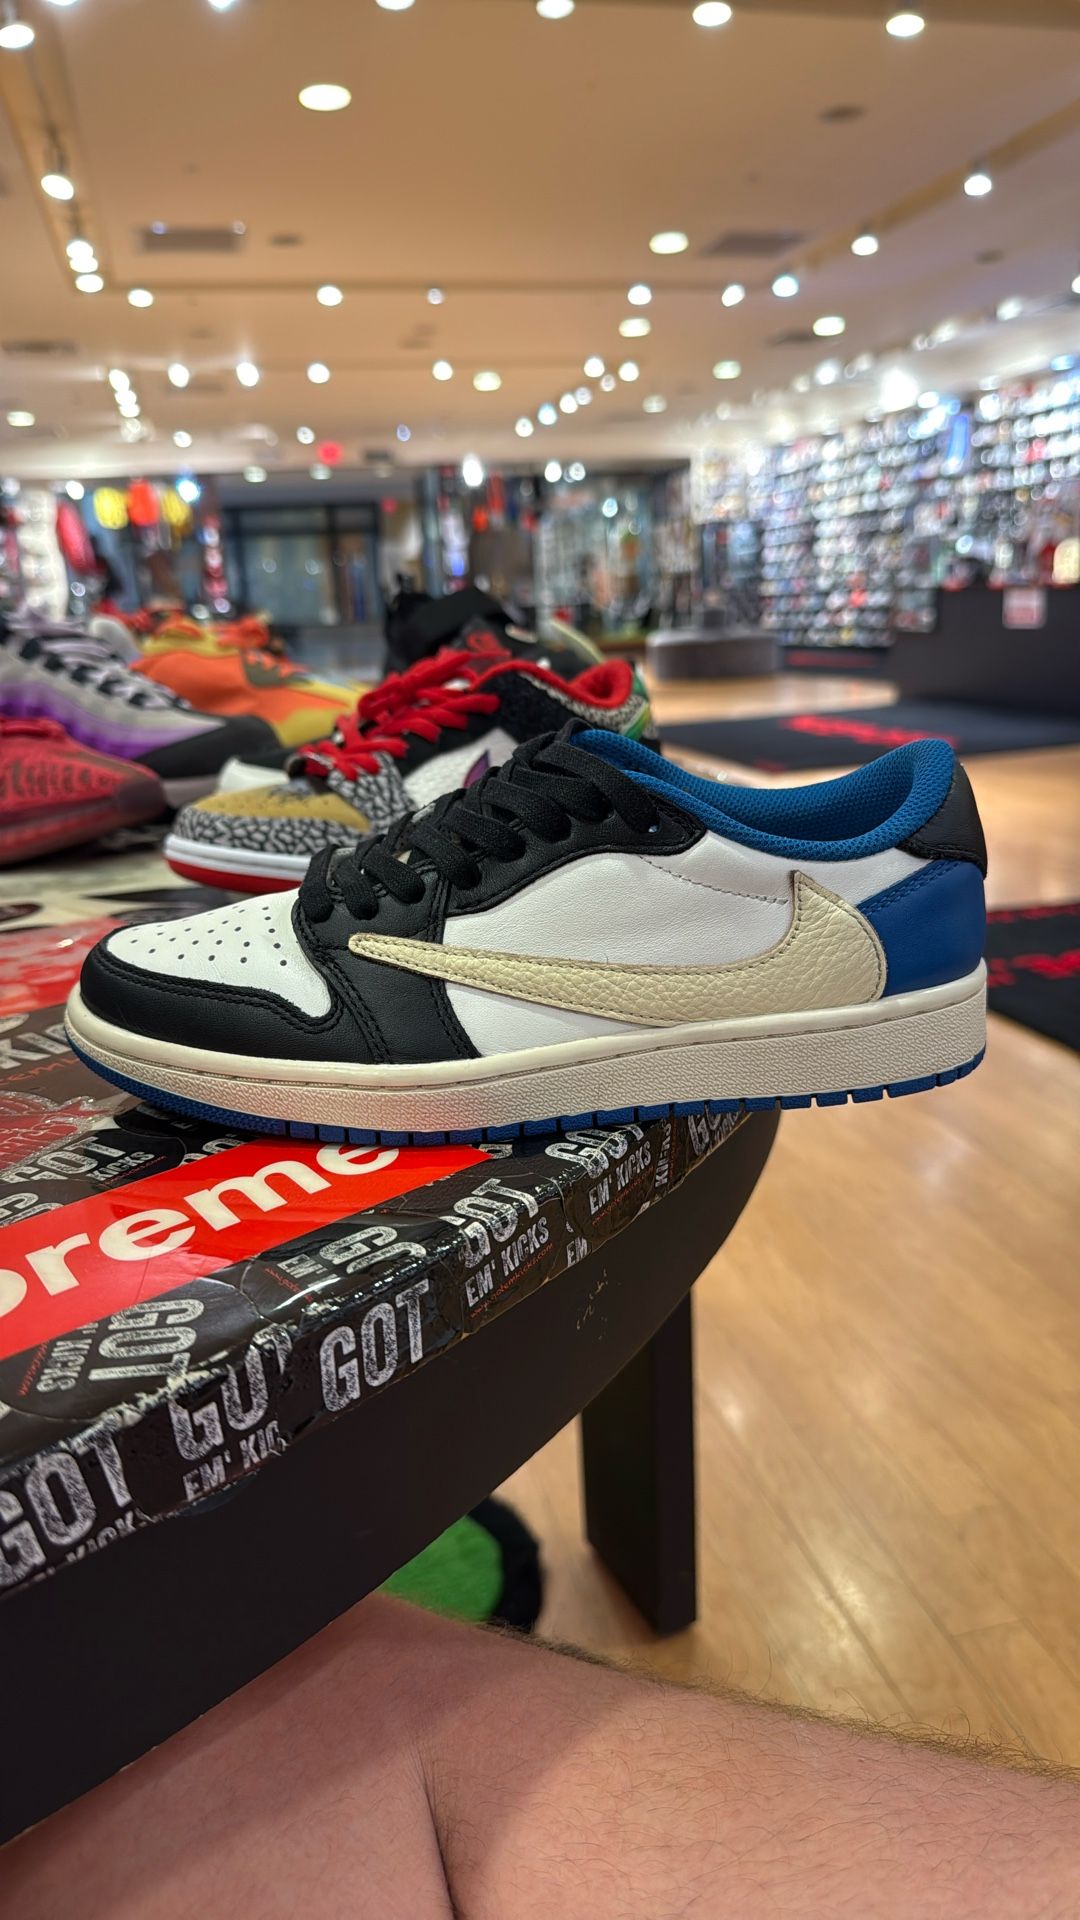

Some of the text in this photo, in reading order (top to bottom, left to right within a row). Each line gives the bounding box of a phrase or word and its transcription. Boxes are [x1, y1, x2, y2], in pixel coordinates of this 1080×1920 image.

[86, 1151, 155, 1182] KICKS
[615, 1141, 652, 1191] KICKS
[437, 1177, 539, 1269] GOT
[465, 1216, 549, 1308] EM' KICKS
[36, 1338, 92, 1392] KICKS
[88, 1299, 204, 1381] GOT
[320, 1278, 430, 1412] GOT
[183, 1450, 231, 1501] EM'
